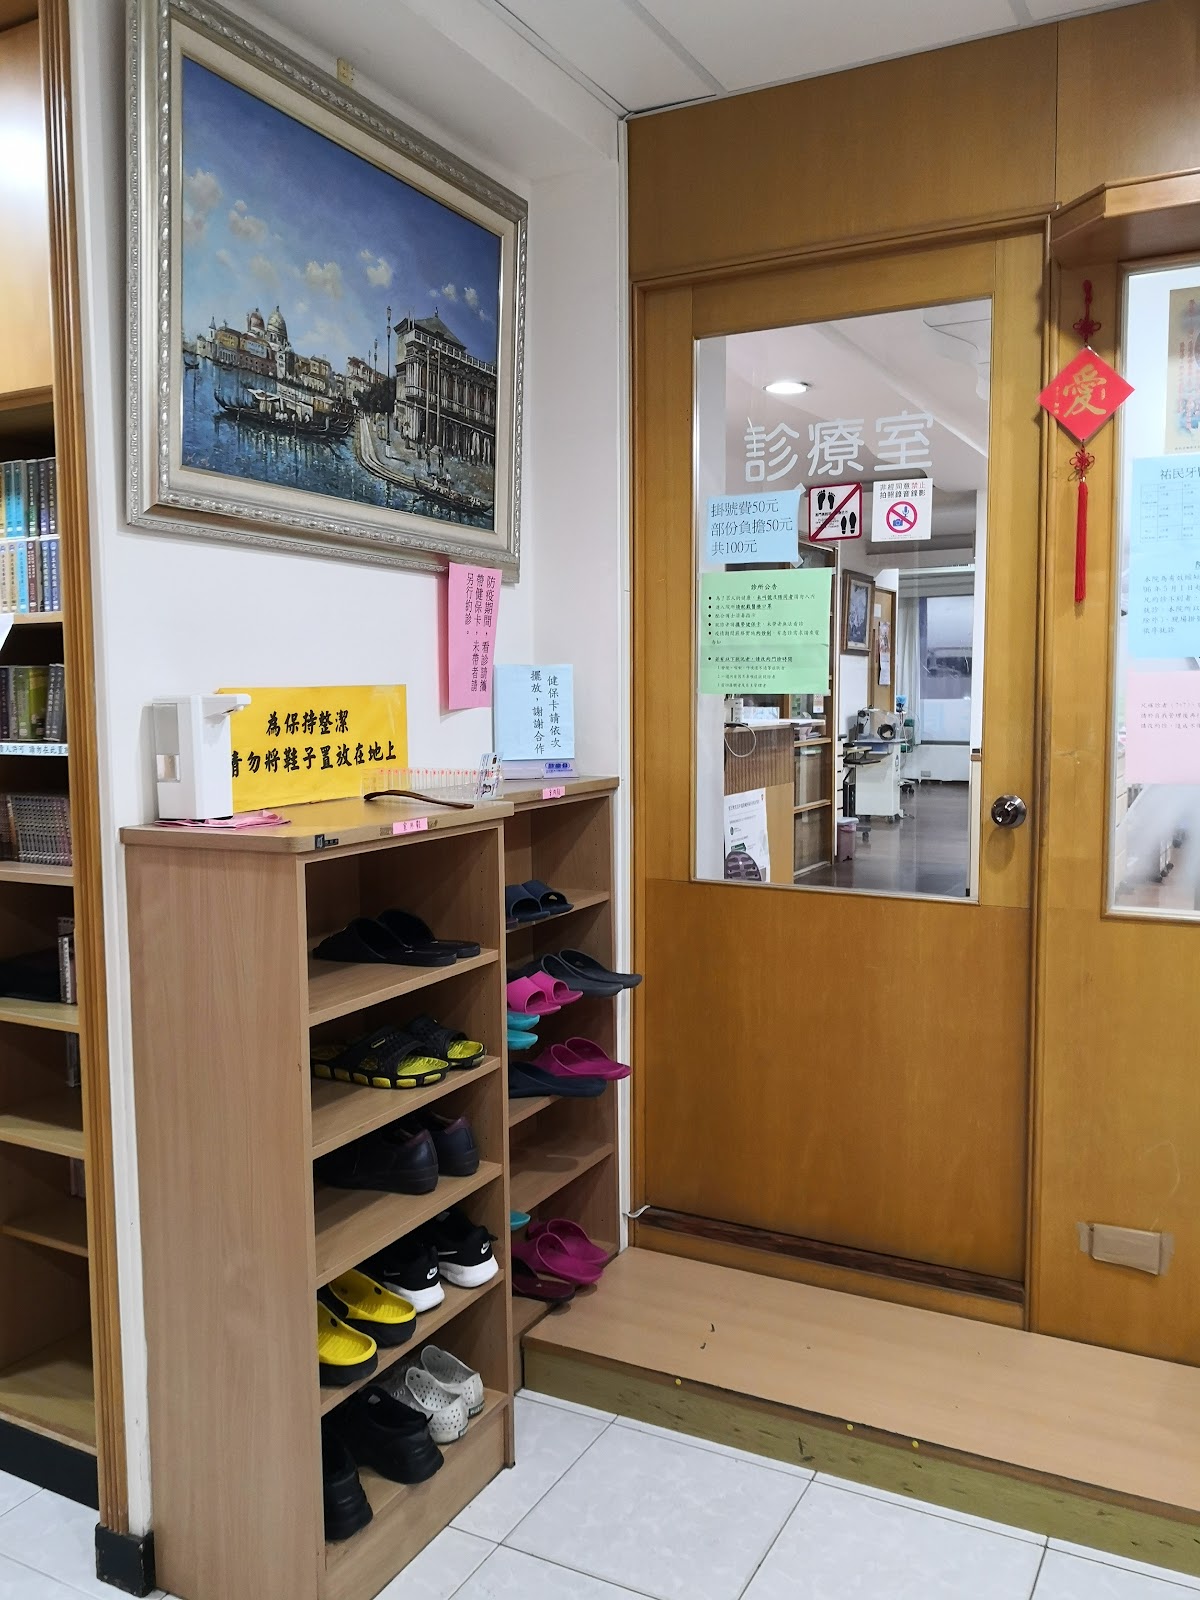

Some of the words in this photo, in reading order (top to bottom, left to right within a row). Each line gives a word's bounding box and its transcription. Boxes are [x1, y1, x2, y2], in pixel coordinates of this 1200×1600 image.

[1063, 363, 1107, 418] 愛
[744, 410, 935, 482] 診療室
[1160, 466, 1200, 480] 祐民牙
[711, 498, 779, 517] 掛號費50元
[711, 517, 793, 537] 部份負擔50元
[711, 540, 758, 556] 共100元
[266, 709, 349, 738] 為保持整潔
[530, 670, 545, 755] 擺放，謝謝合作
[547, 675, 562, 748] 健保卡請依次
